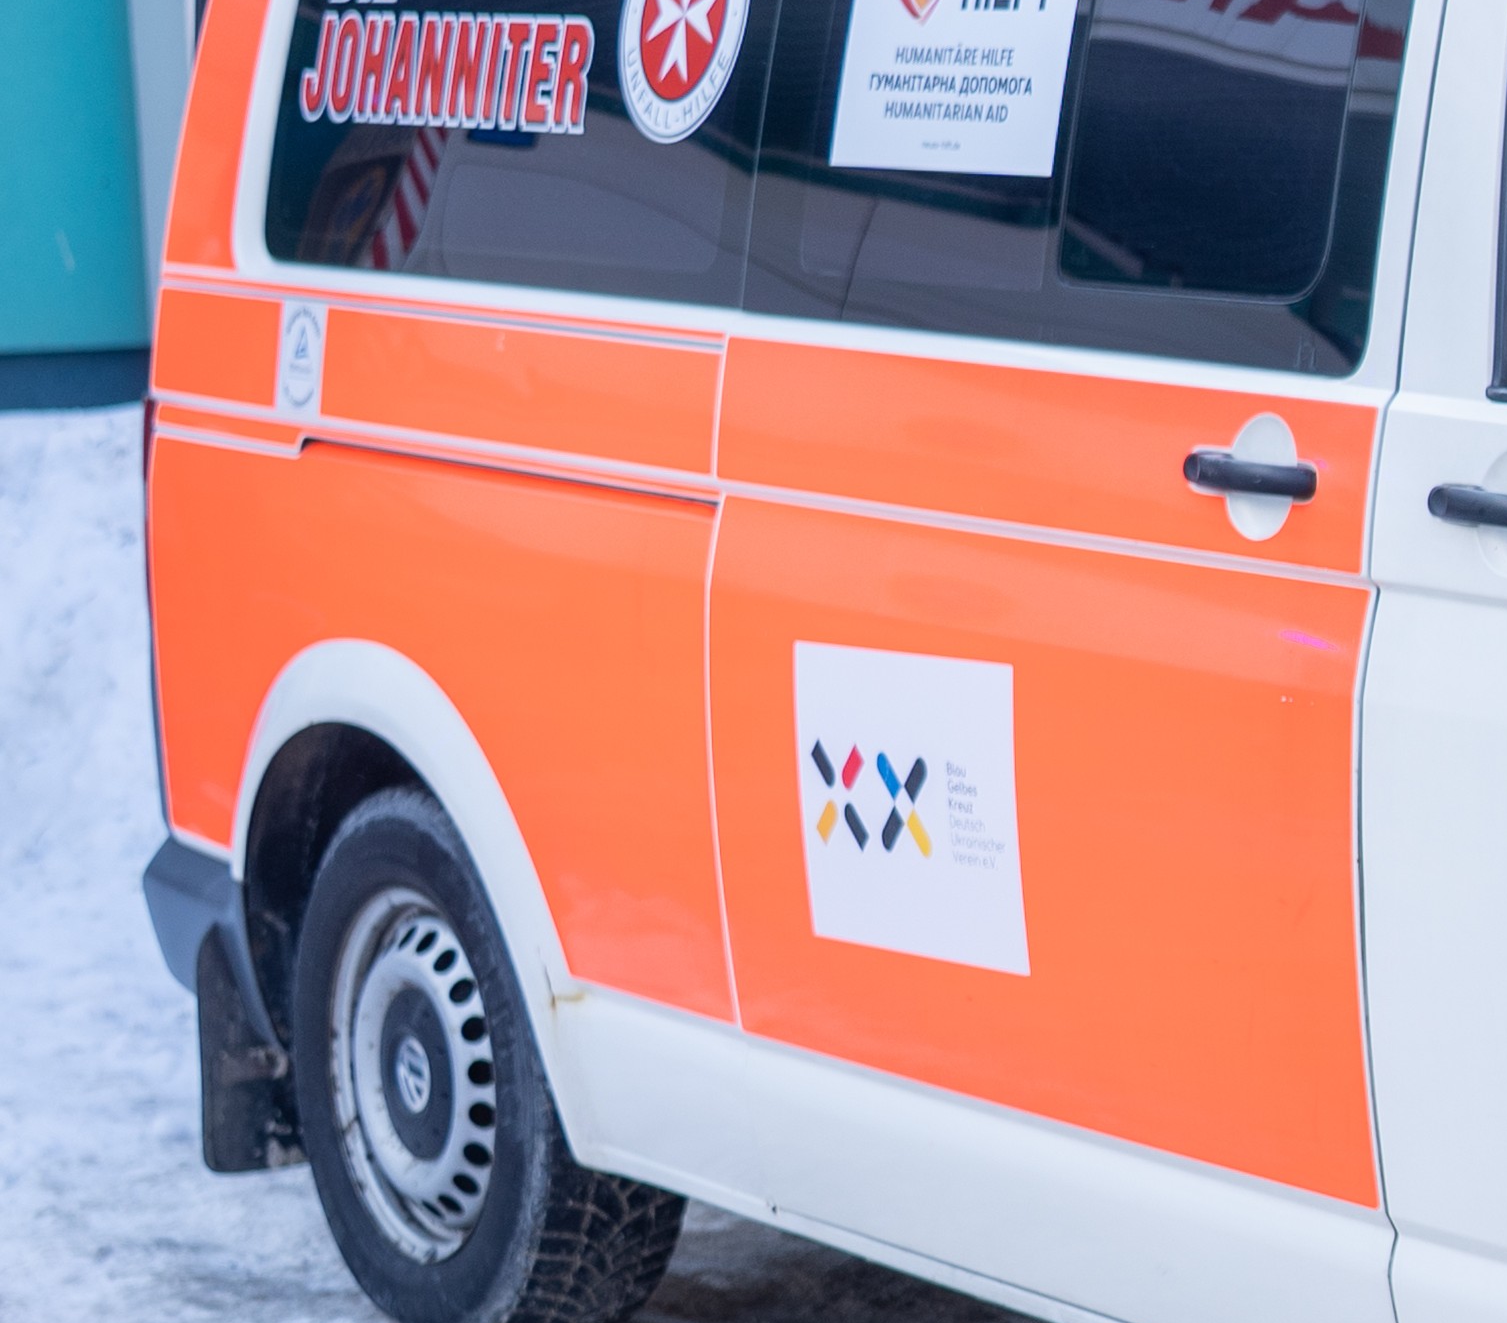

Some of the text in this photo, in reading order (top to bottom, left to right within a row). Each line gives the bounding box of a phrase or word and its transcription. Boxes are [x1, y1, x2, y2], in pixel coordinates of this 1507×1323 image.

[894, 43, 1015, 67] HUMANITÄRE HILFE
[300, 9, 595, 135] JOHANNITER
[869, 73, 1032, 96] ГУМАНІТАРНА ДОПОМОГА
[884, 101, 1008, 122] HUMANITARIAN AID
[946, 761, 967, 778] Blau
[947, 779, 977, 796] Gelbes
[948, 798, 974, 814] Kreuz
